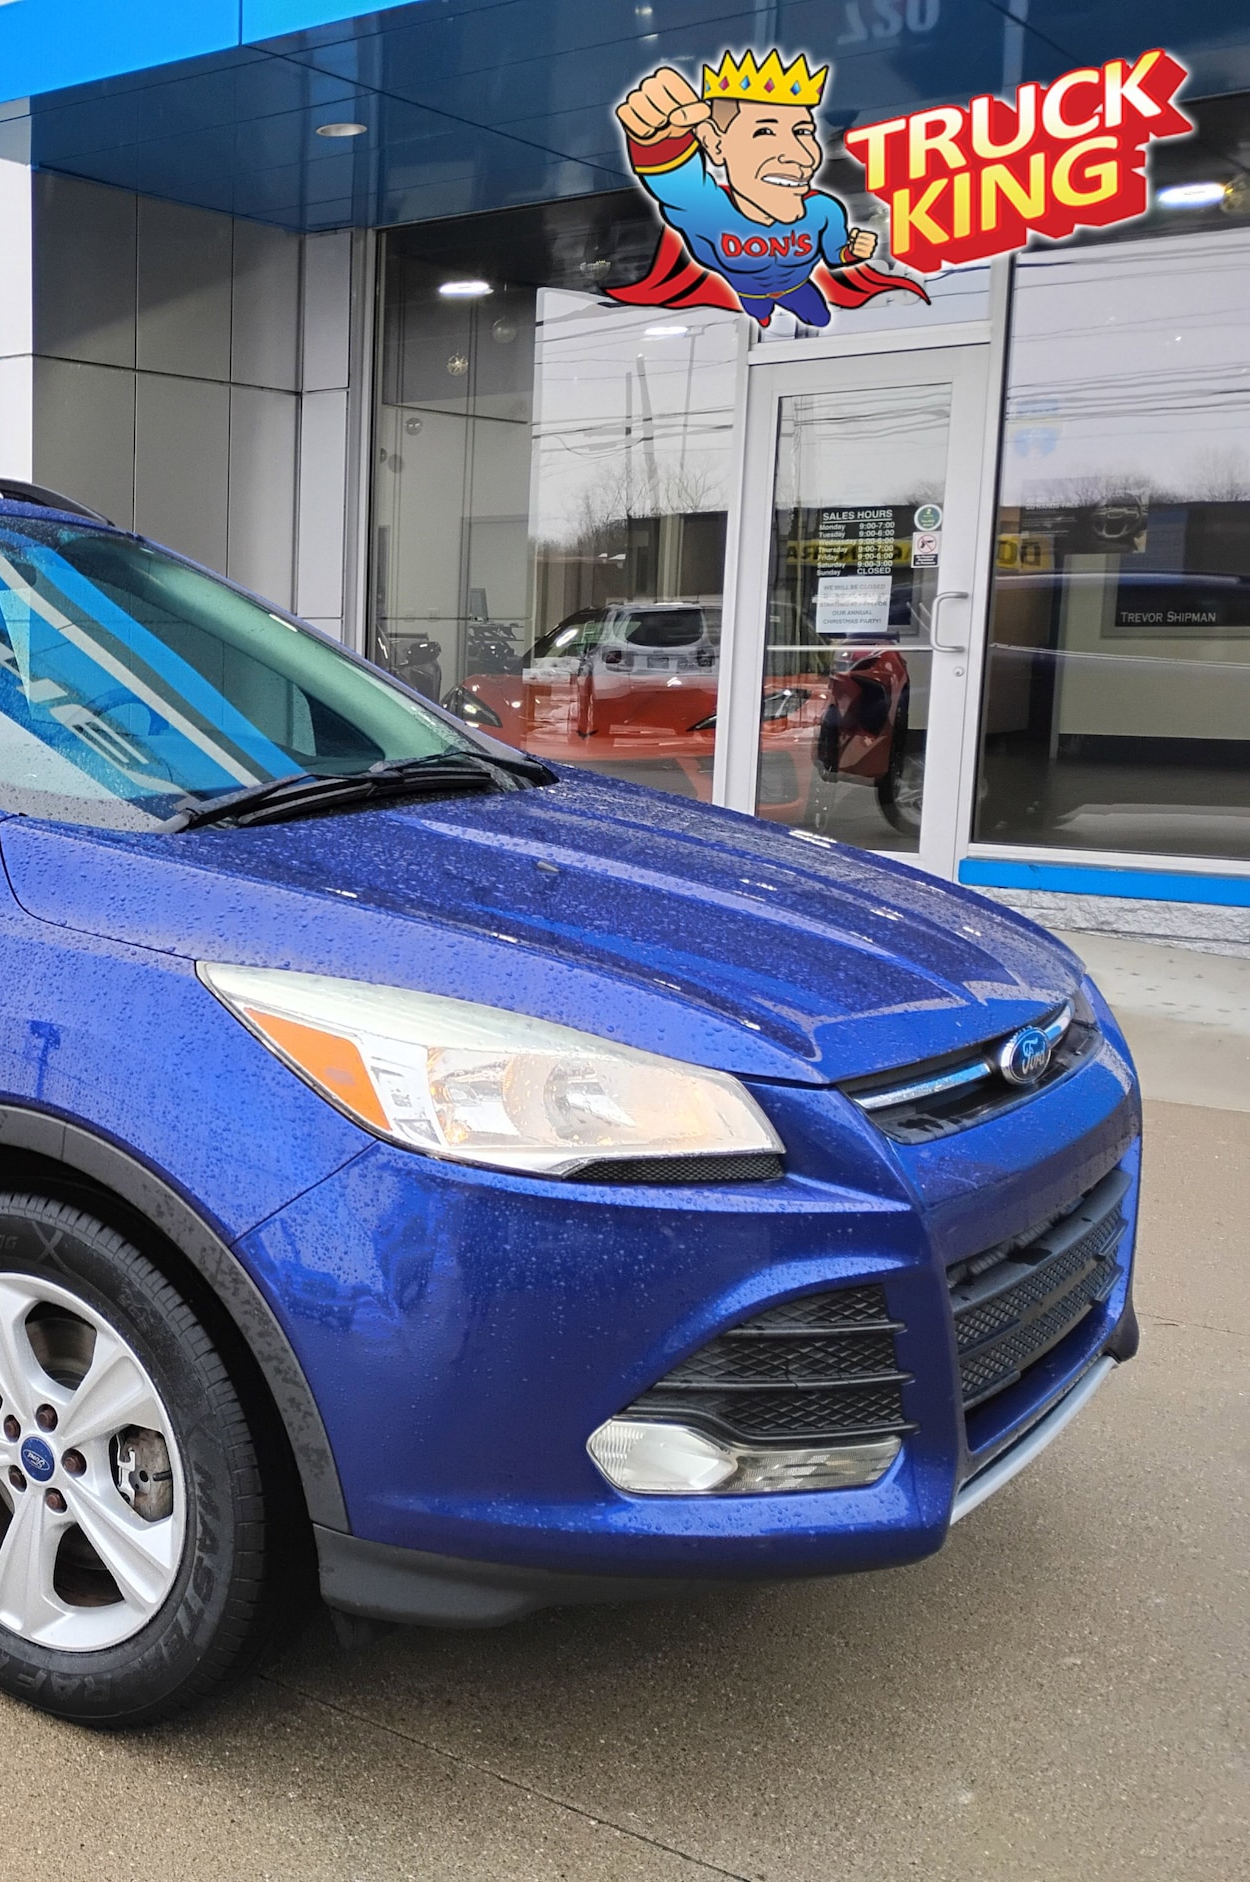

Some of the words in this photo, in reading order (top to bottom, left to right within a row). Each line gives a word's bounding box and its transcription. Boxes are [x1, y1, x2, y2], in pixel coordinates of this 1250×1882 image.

[822, 511, 855, 521] SALES
[857, 509, 893, 519] HOURS
[1120, 611, 1163, 623] TREVOR
[1166, 611, 1216, 623] SHIPMAN
